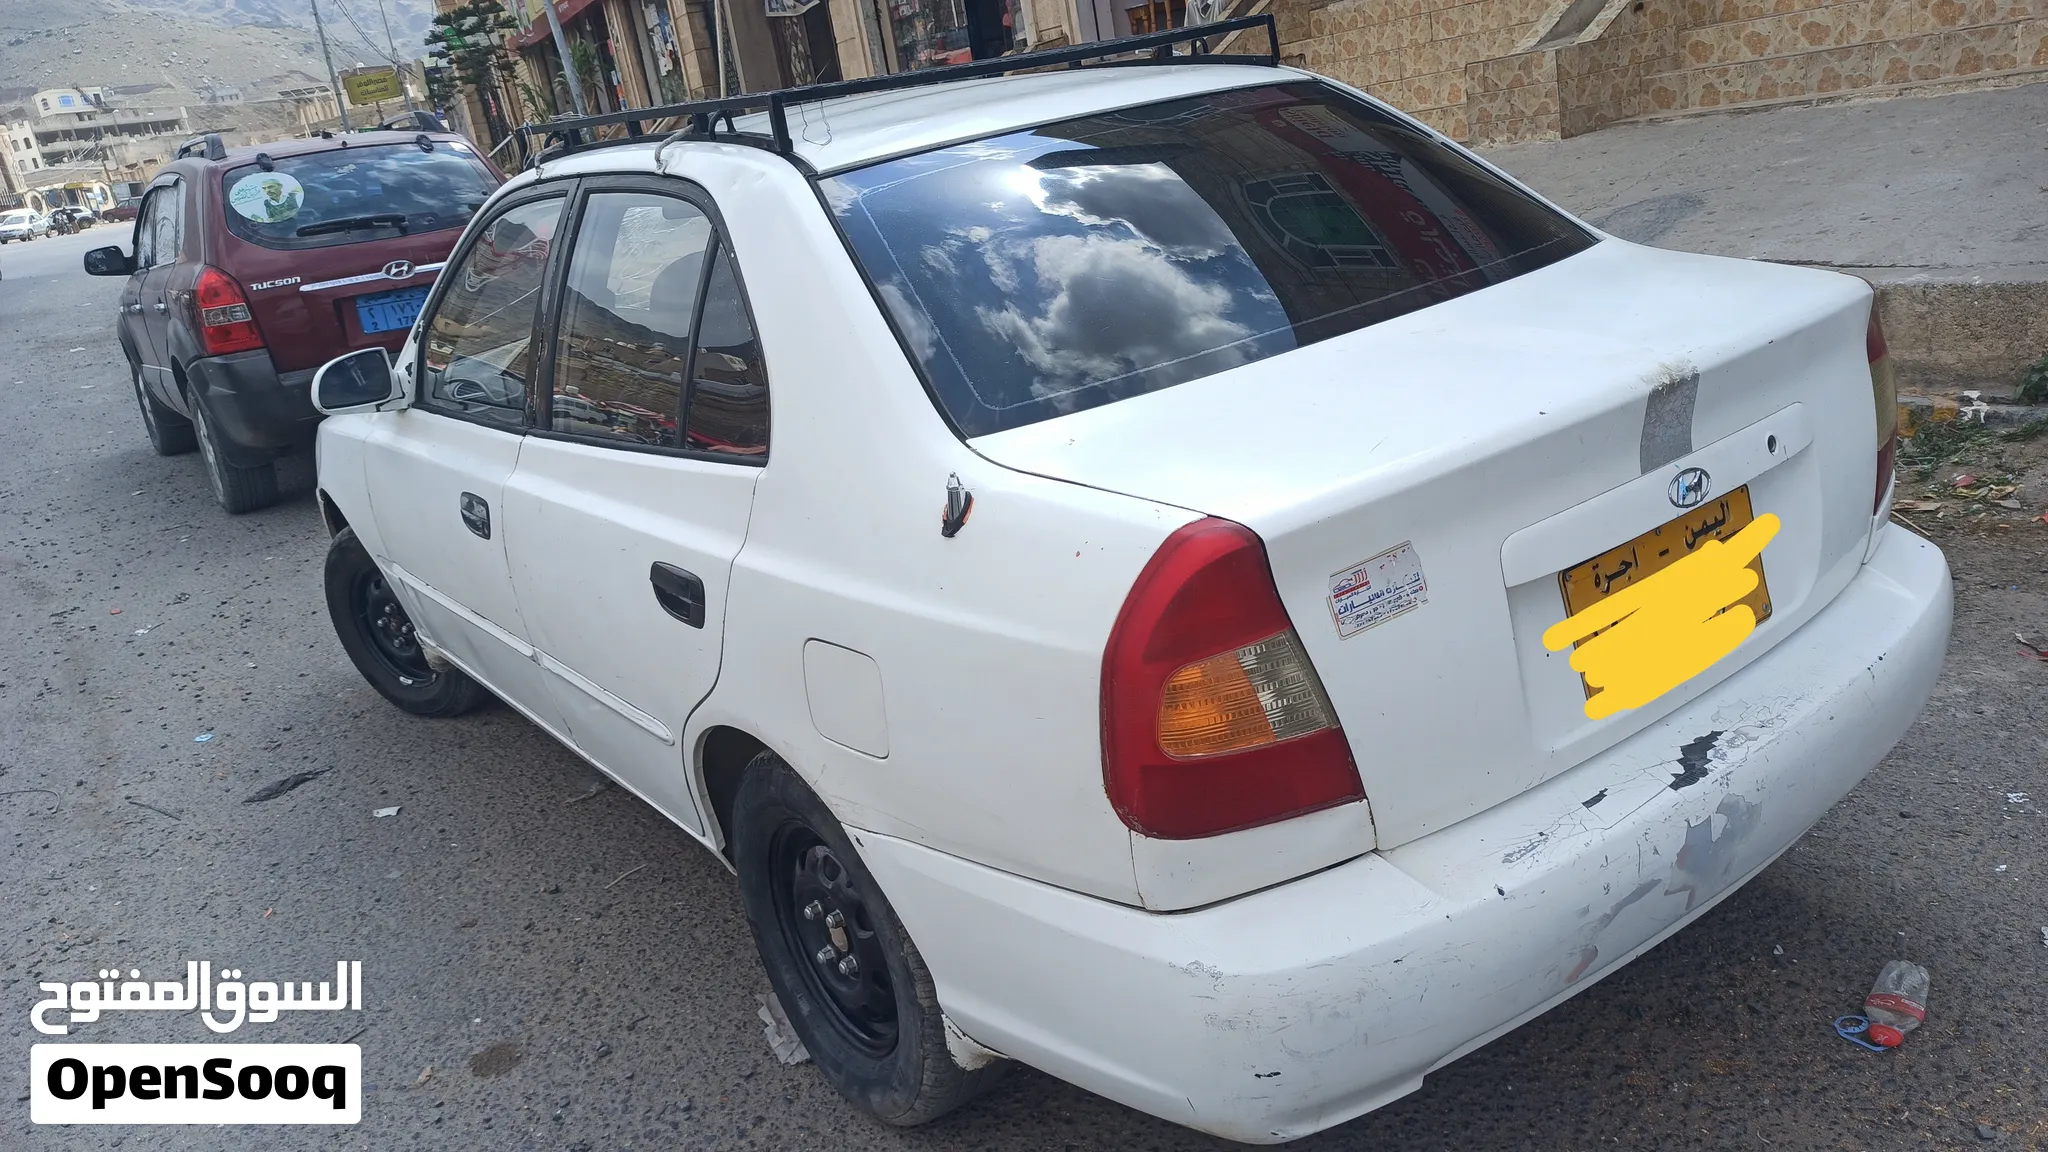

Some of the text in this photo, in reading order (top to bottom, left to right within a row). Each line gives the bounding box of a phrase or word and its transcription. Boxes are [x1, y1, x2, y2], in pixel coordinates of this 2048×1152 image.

[390, 300, 426, 315] ١٧٦٠
[371, 315, 417, 331] 2 176
[1683, 499, 1731, 550] اليمن
